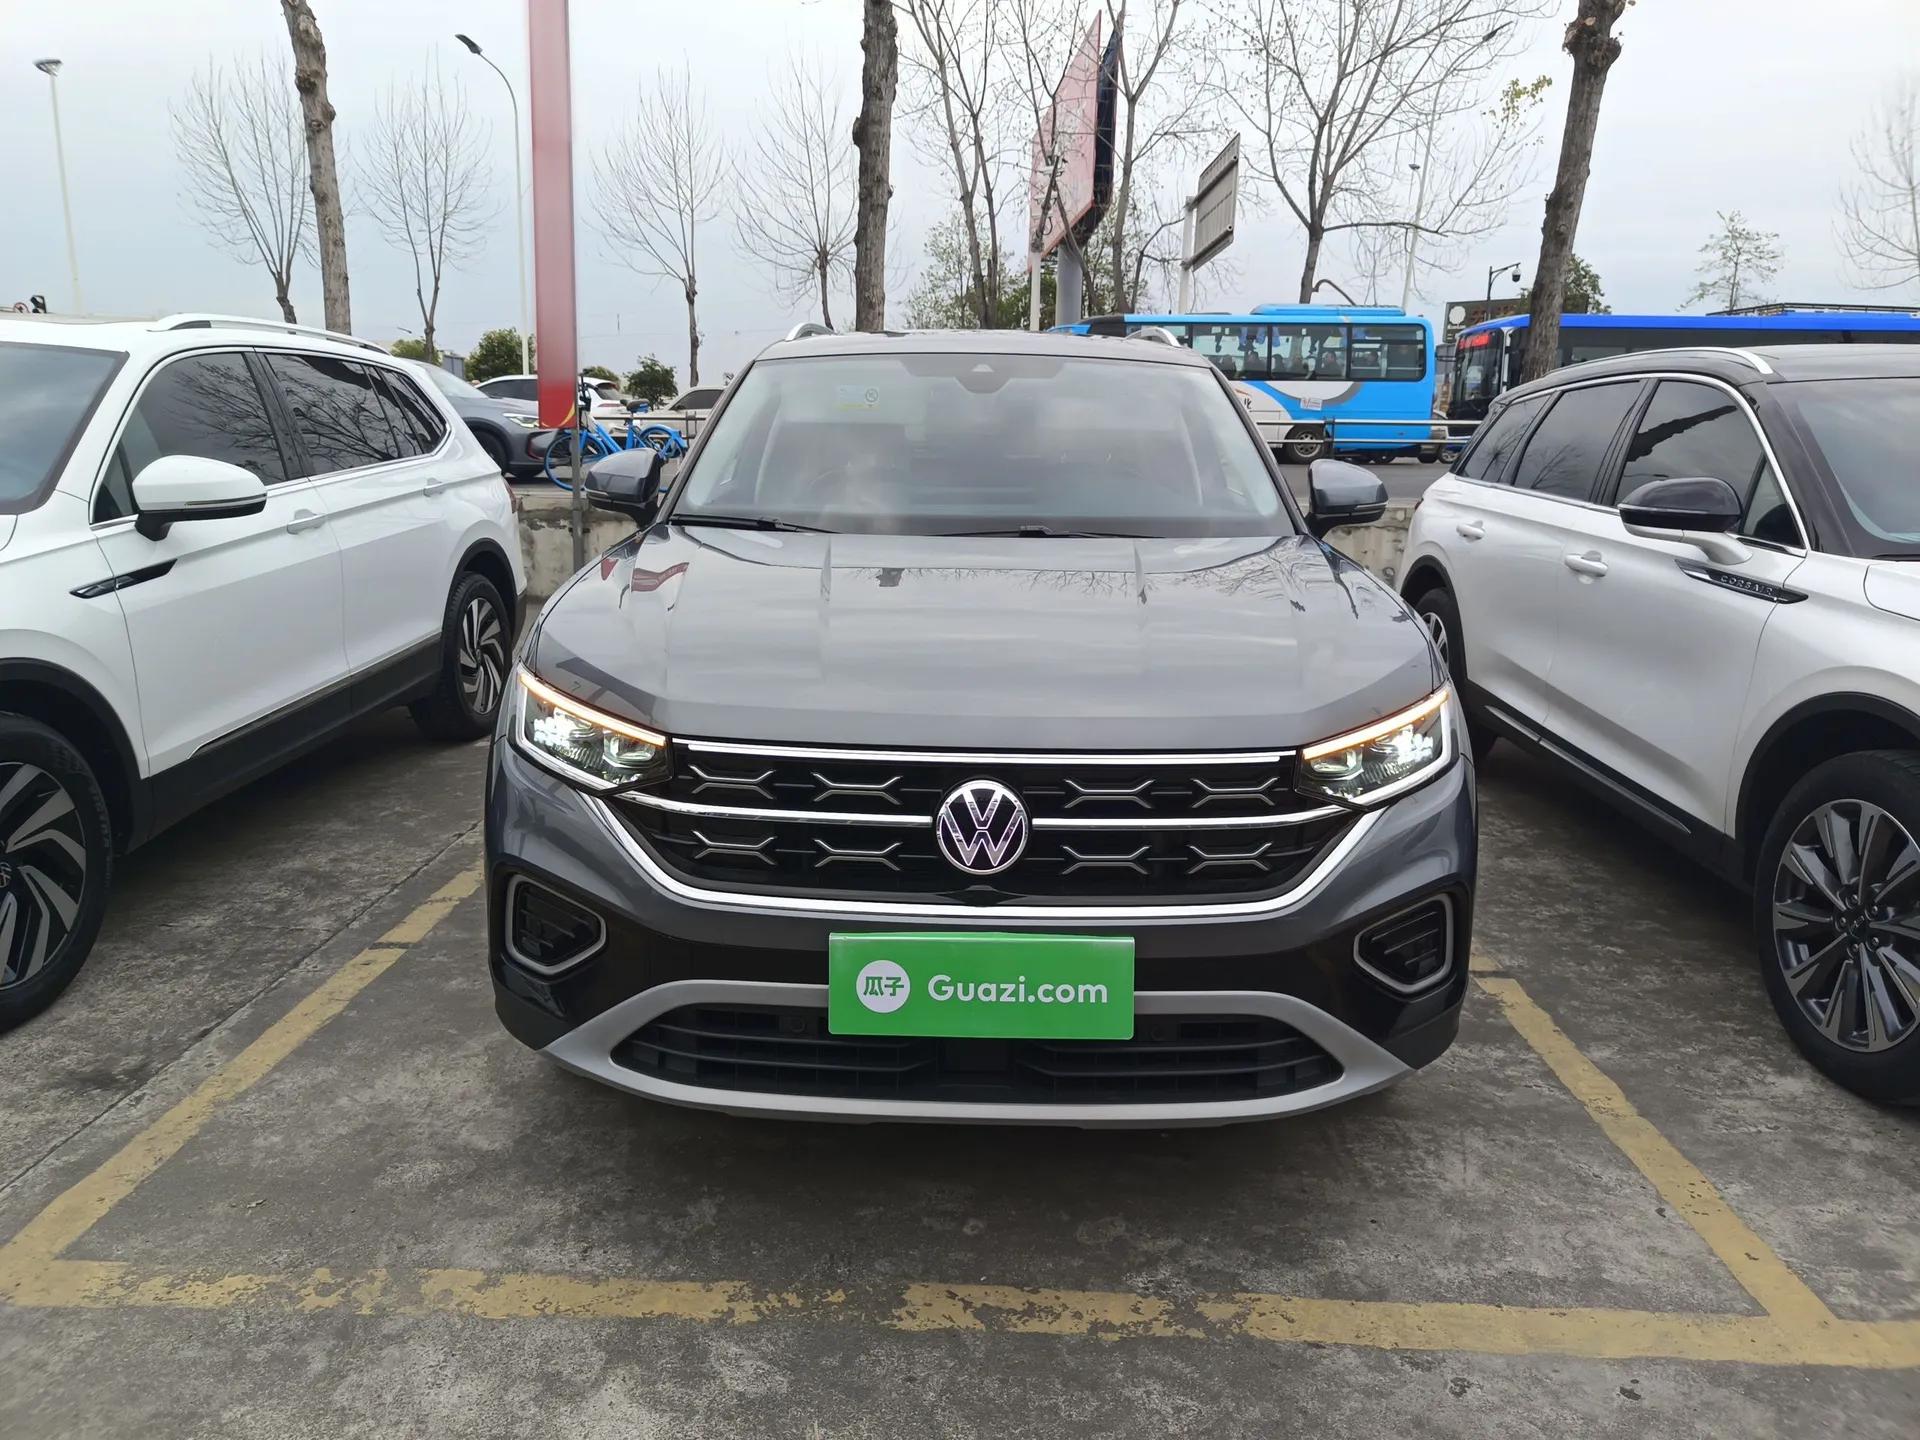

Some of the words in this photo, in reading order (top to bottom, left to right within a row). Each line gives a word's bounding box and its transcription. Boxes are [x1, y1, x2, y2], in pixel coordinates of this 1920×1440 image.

[1720, 575, 1773, 596] CORSAIR
[938, 785, 1025, 869] VW
[863, 976, 904, 997] 瓜子
[928, 974, 1108, 1004] Guazi.com
